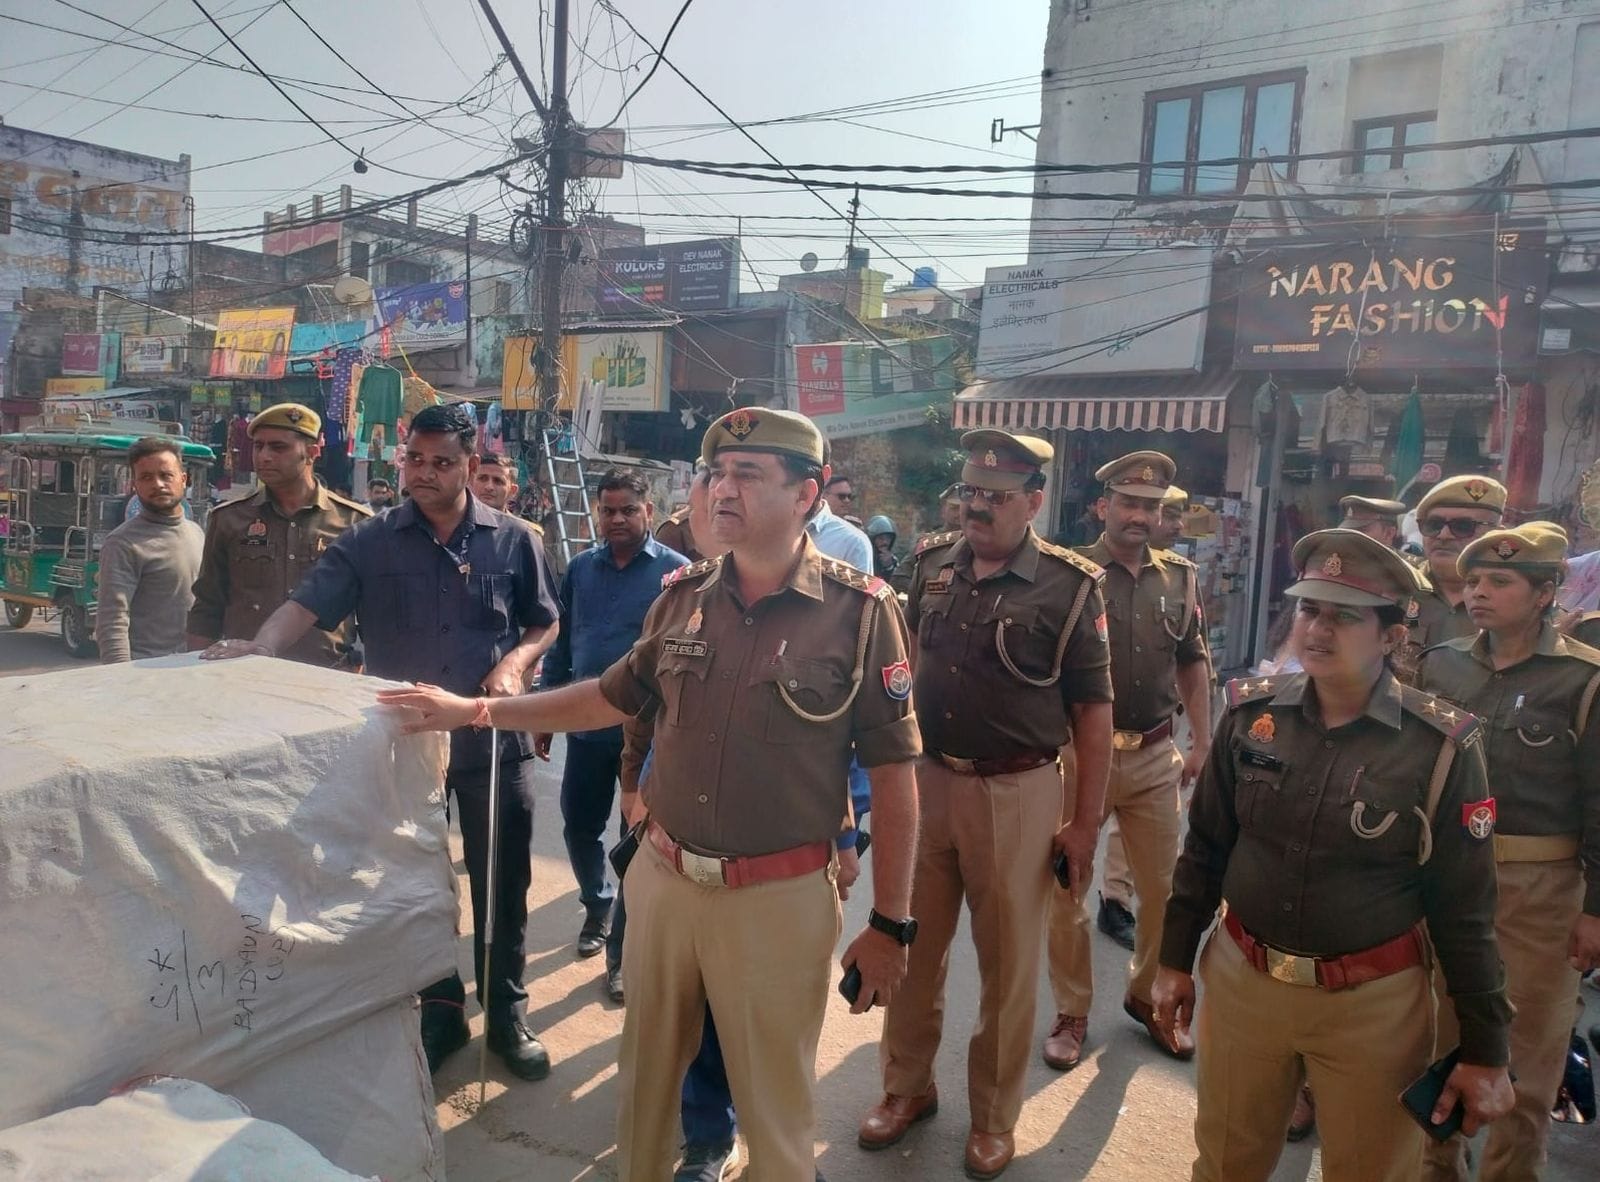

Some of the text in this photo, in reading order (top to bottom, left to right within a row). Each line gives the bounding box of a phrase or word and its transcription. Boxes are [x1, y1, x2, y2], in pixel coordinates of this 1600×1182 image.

[679, 261, 725, 273] ELECTRICALS
[1007, 268, 1044, 280] NANAK
[1266, 257, 1456, 298] NARANG
[989, 280, 1059, 294] ELECTRICALS
